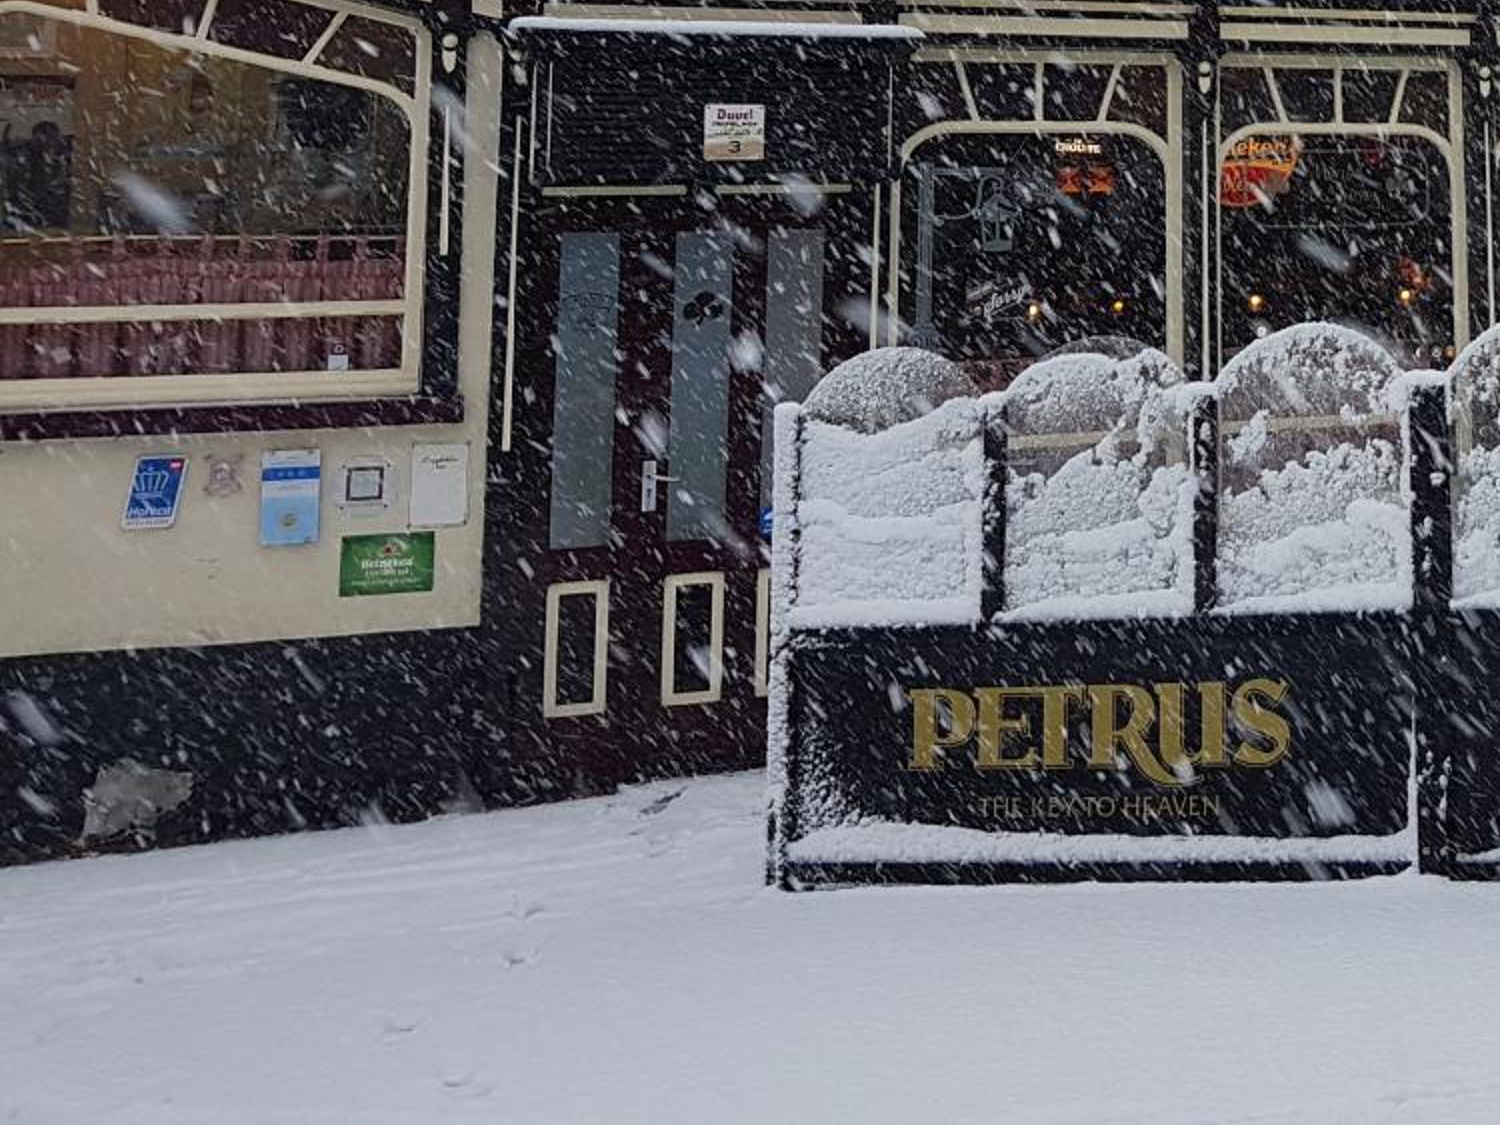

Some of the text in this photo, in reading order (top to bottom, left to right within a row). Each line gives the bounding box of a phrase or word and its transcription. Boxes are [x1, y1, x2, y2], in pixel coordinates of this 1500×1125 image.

[717, 108, 753, 120] Duvel
[728, 140, 741, 154] 3
[907, 678, 1292, 786] PETRUS
[978, 795, 1220, 819] THE KEY TO HEAVEN
